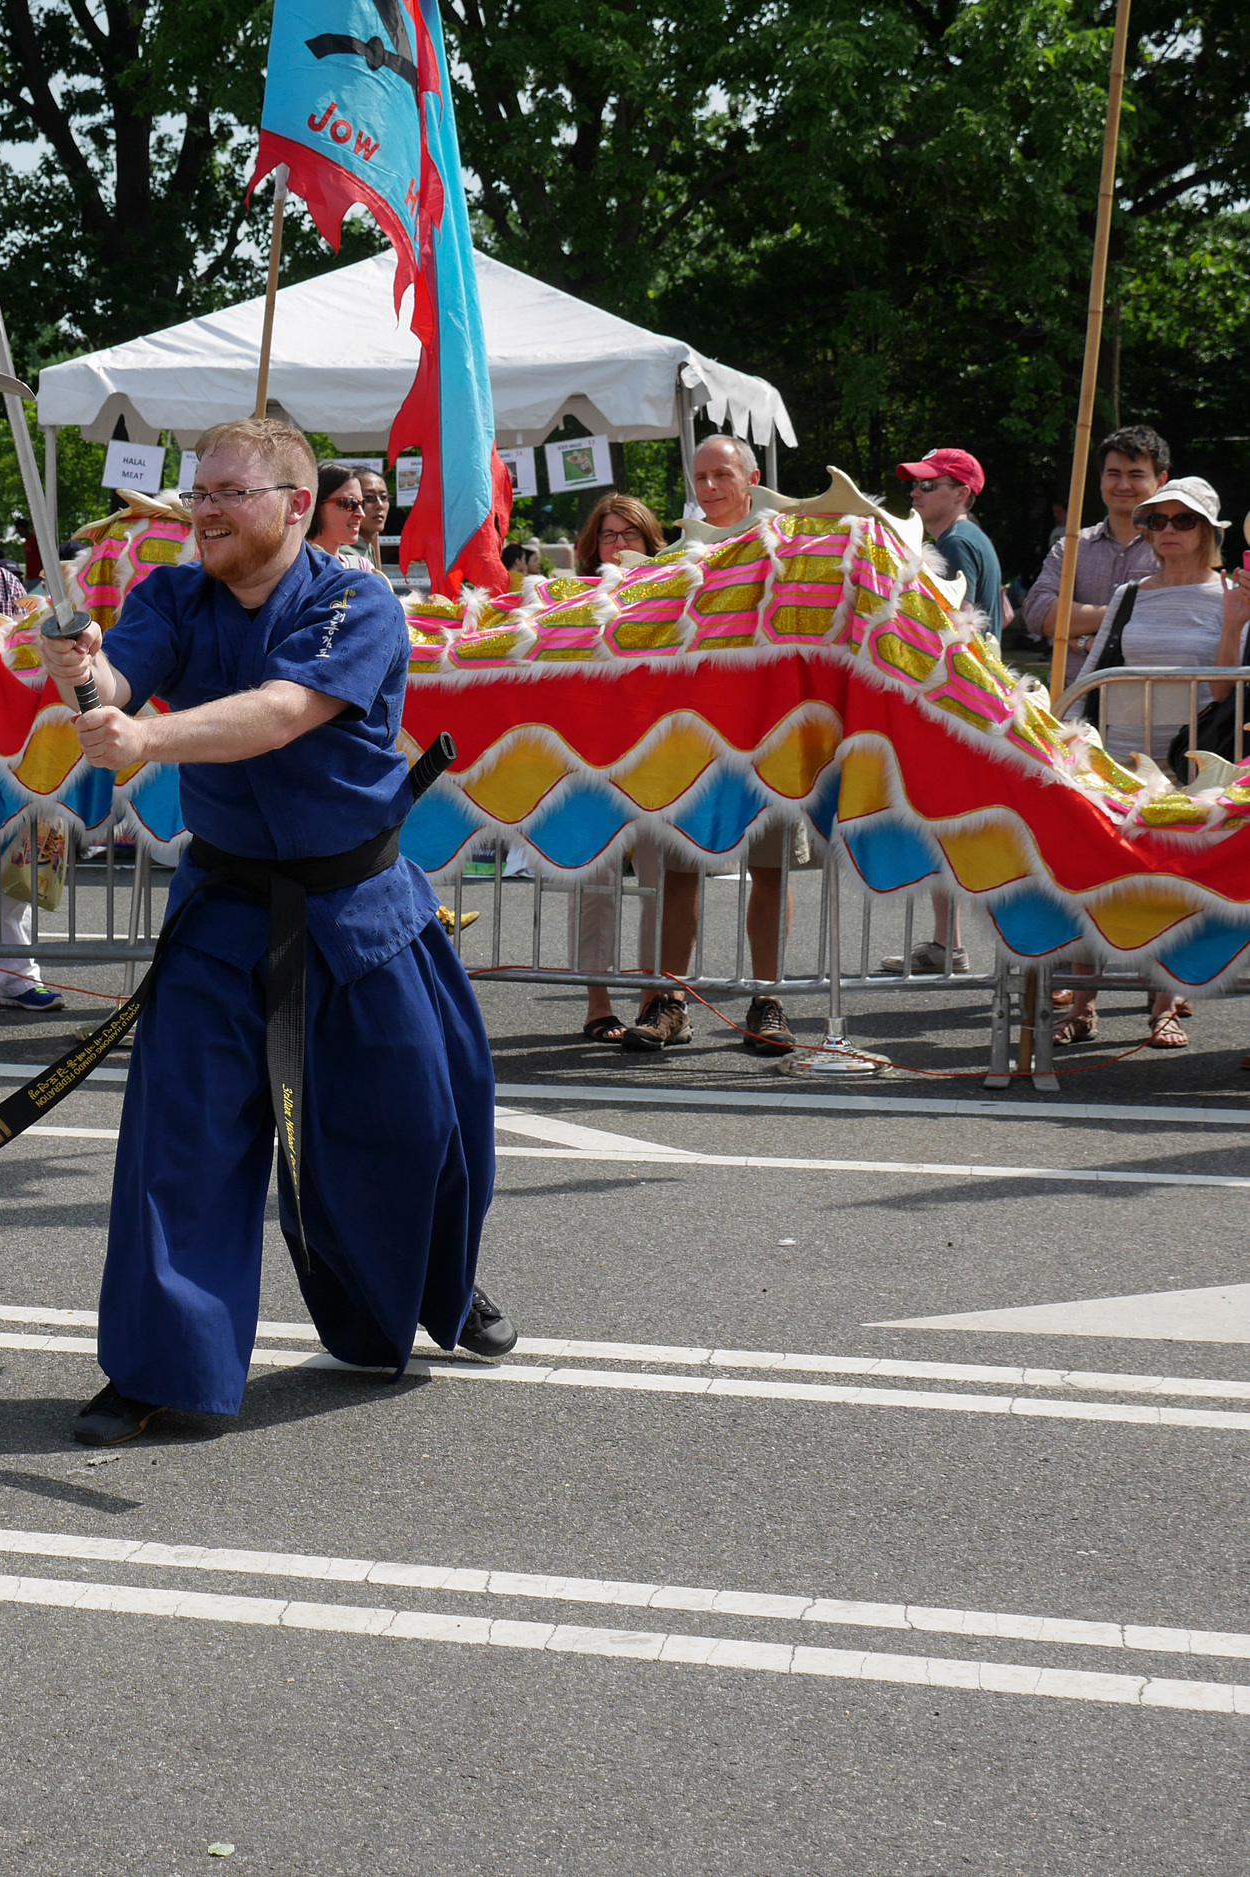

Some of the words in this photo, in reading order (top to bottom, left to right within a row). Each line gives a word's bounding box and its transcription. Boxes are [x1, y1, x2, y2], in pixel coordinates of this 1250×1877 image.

[122, 456, 146, 467] HALAL
[121, 470, 144, 480] MEAT
[121, 1003, 141, 1028] WORLD
[96, 1027, 122, 1054] HAIDONG
[74, 1054, 97, 1075] GUMDO
[35, 1075, 76, 1108] FEDERATION
